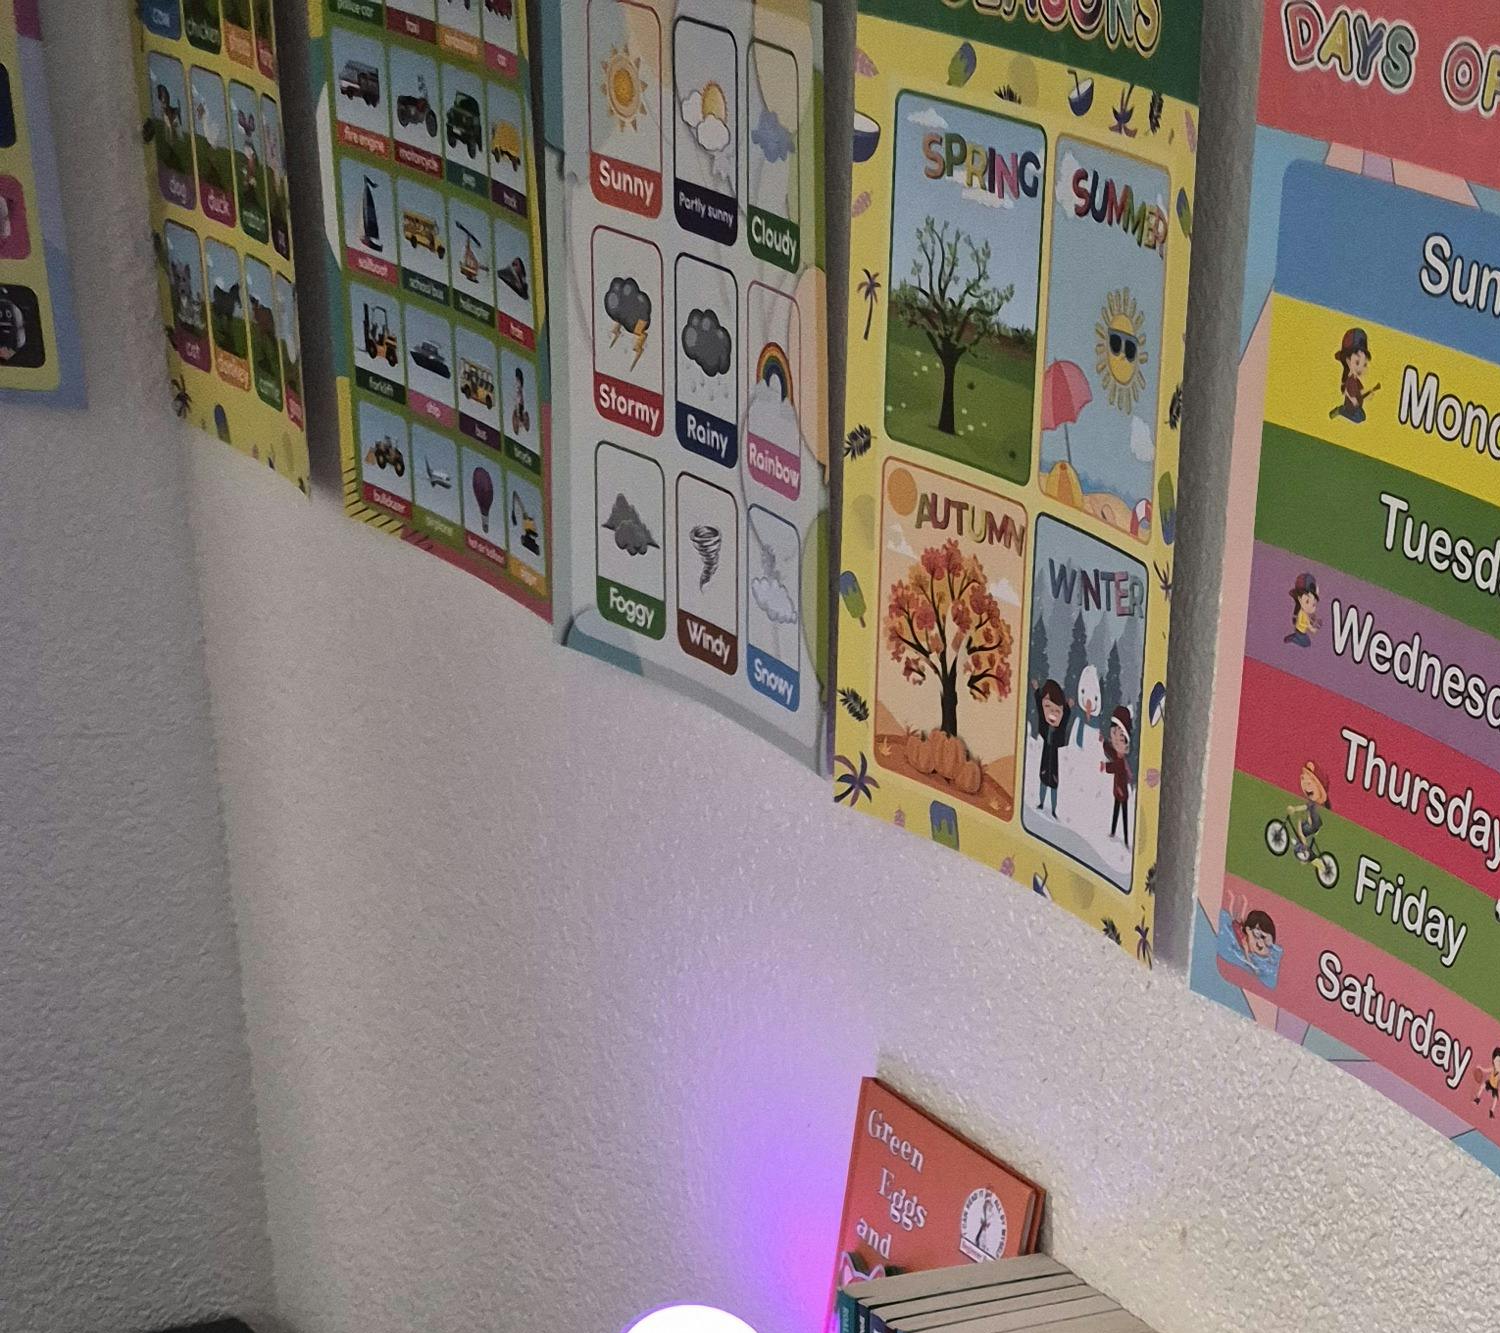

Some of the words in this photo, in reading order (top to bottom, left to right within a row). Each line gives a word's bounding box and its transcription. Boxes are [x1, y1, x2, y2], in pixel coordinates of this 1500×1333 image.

[1281, 2, 1418, 93] DAYS
[599, 160, 654, 206] Sunny
[922, 133, 1040, 199] SPRING
[679, 191, 706, 217] Partly
[707, 204, 733, 227] sunny
[1072, 168, 1168, 252] SUMMER
[752, 215, 797, 265] Cloudy
[600, 384, 660, 425] Stormy
[687, 415, 728, 457] Rainy
[749, 443, 799, 488] Rainbow
[915, 492, 1026, 556] AUTUMN
[609, 587, 654, 629] Foggy
[1049, 557, 1145, 619] WINTER
[687, 619, 730, 664] Windy
[754, 658, 793, 704] Snowy
[1354, 856, 1467, 967] Friday
[1316, 951, 1473, 1090] Saturday
[868, 1109, 924, 1173] Green
[879, 1167, 928, 1231] Eggs
[856, 1218, 892, 1260] and
